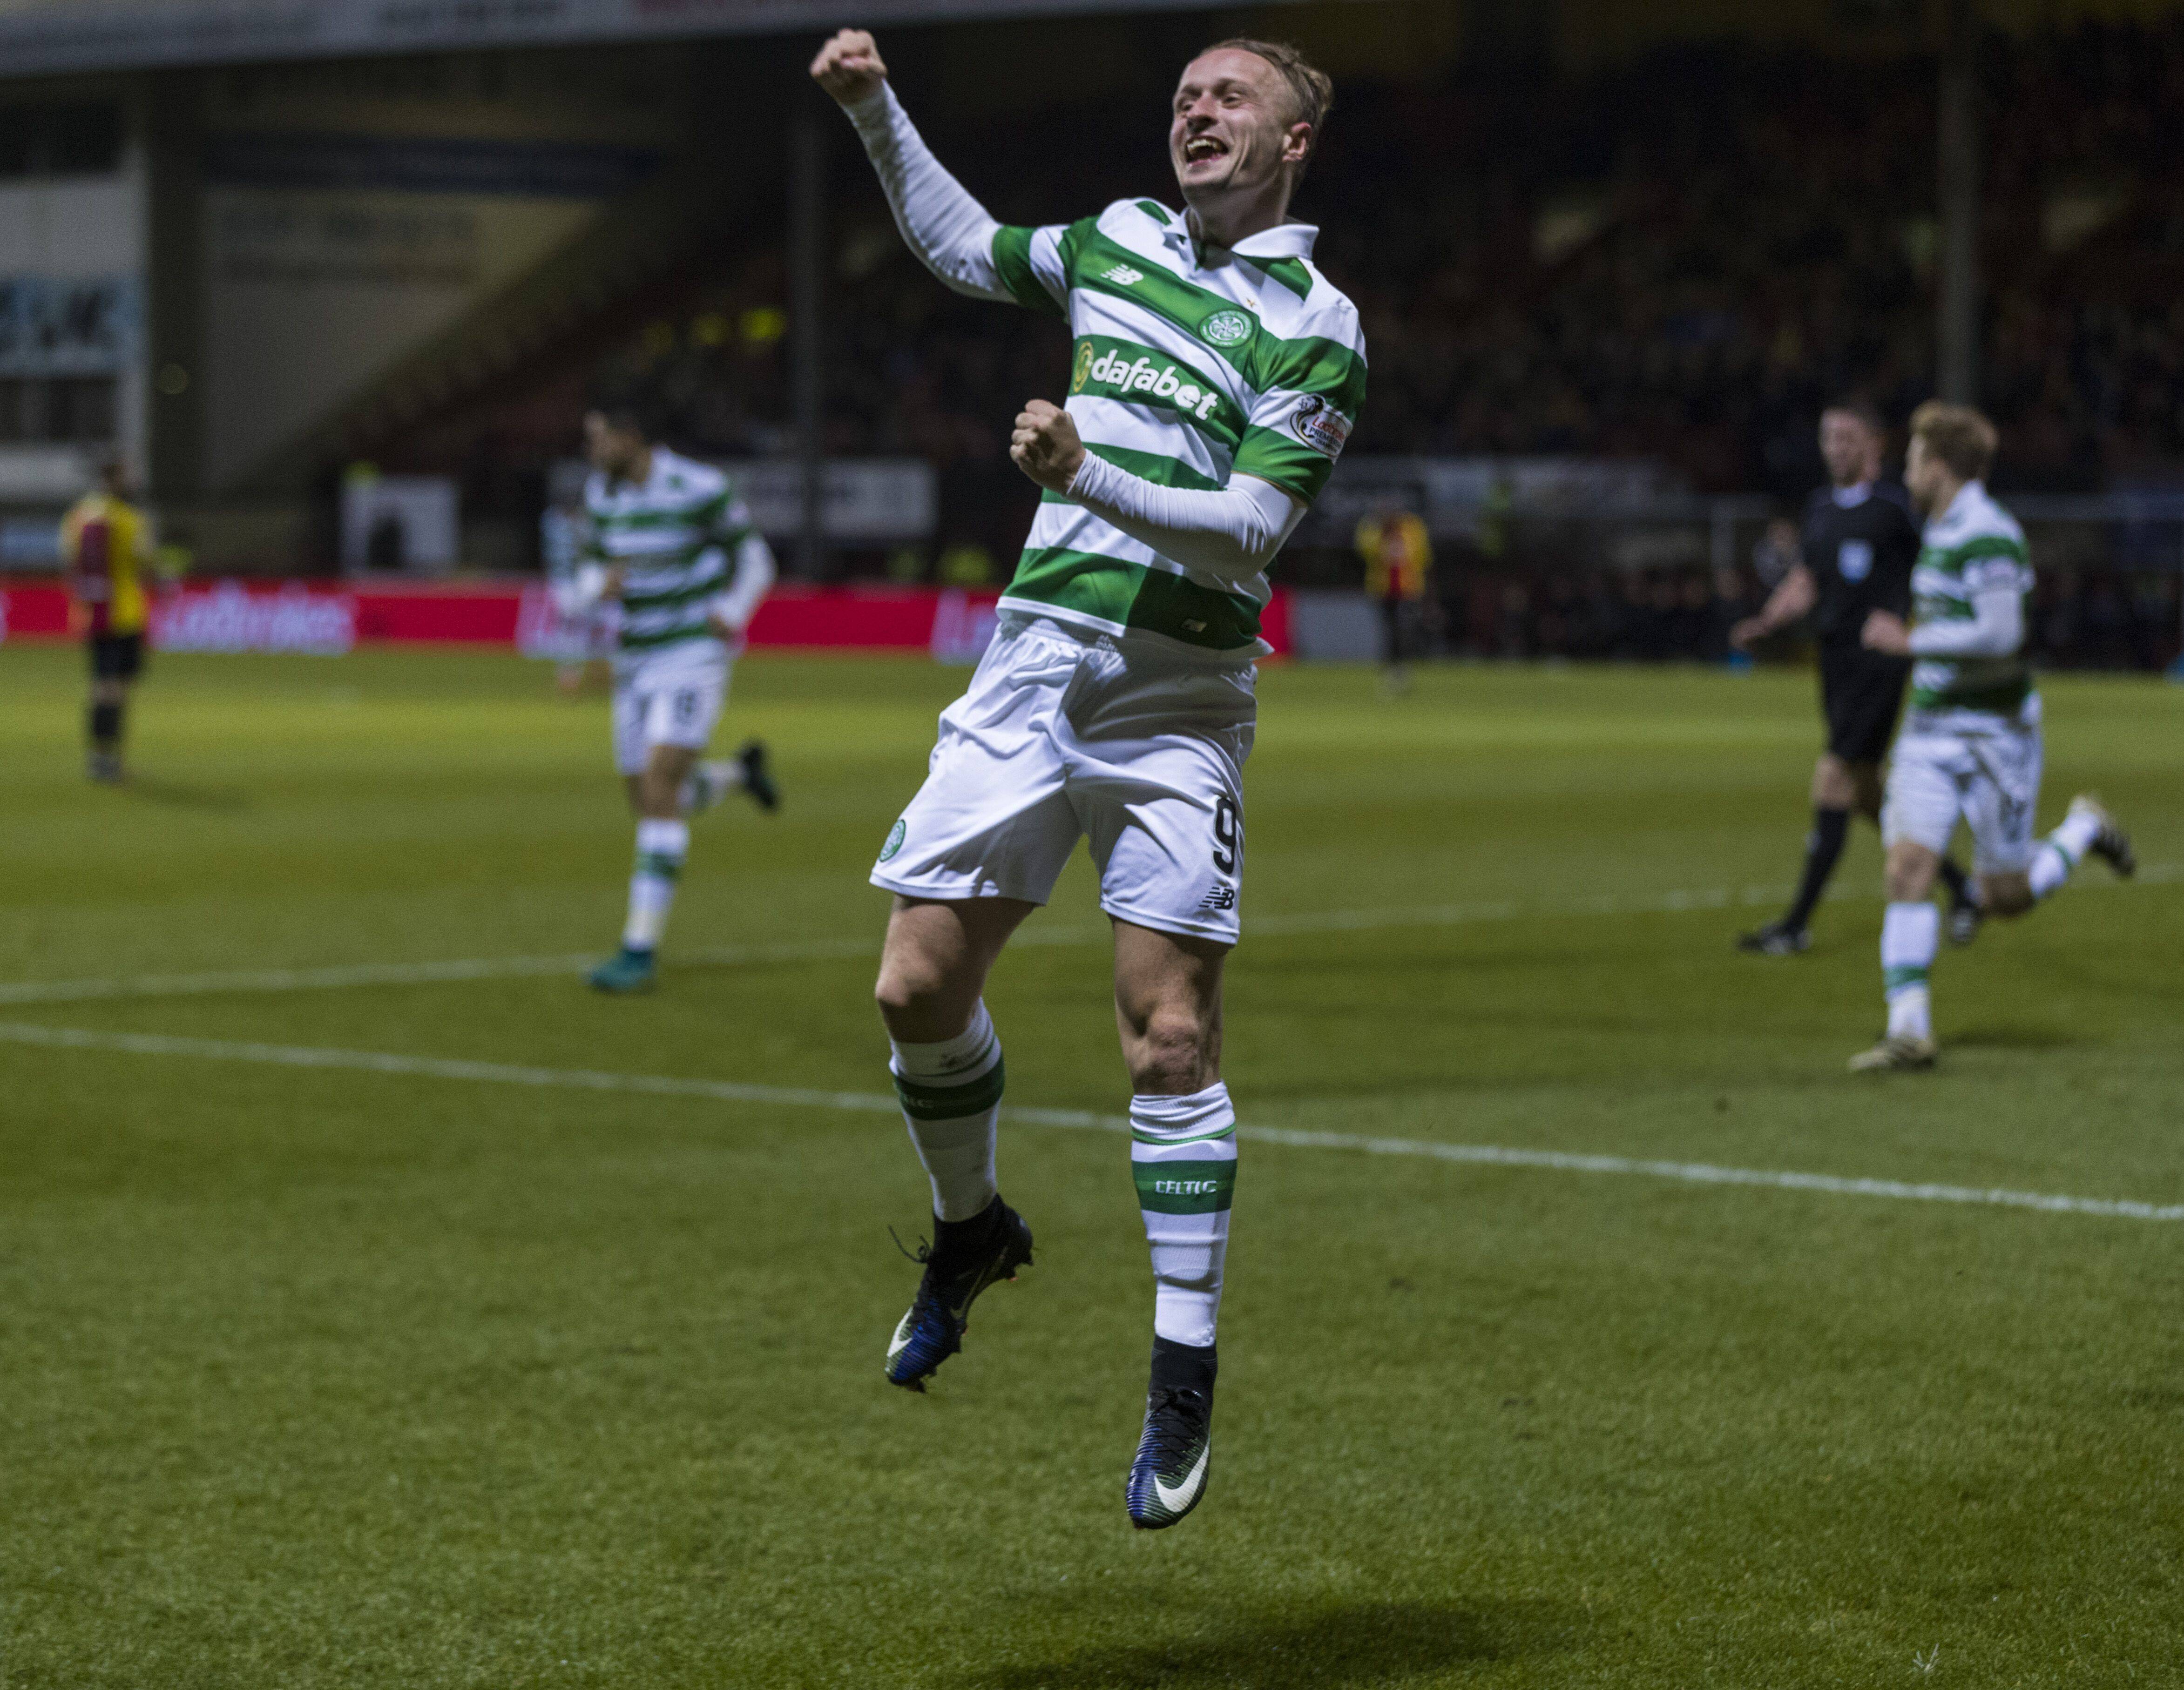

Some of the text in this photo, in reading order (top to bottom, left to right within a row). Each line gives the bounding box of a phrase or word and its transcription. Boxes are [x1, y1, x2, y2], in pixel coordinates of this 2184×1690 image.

[1091, 349, 1218, 420] dafabet
[1213, 797, 1237, 875] 9
[1156, 1180, 1217, 1195] CELTIC
